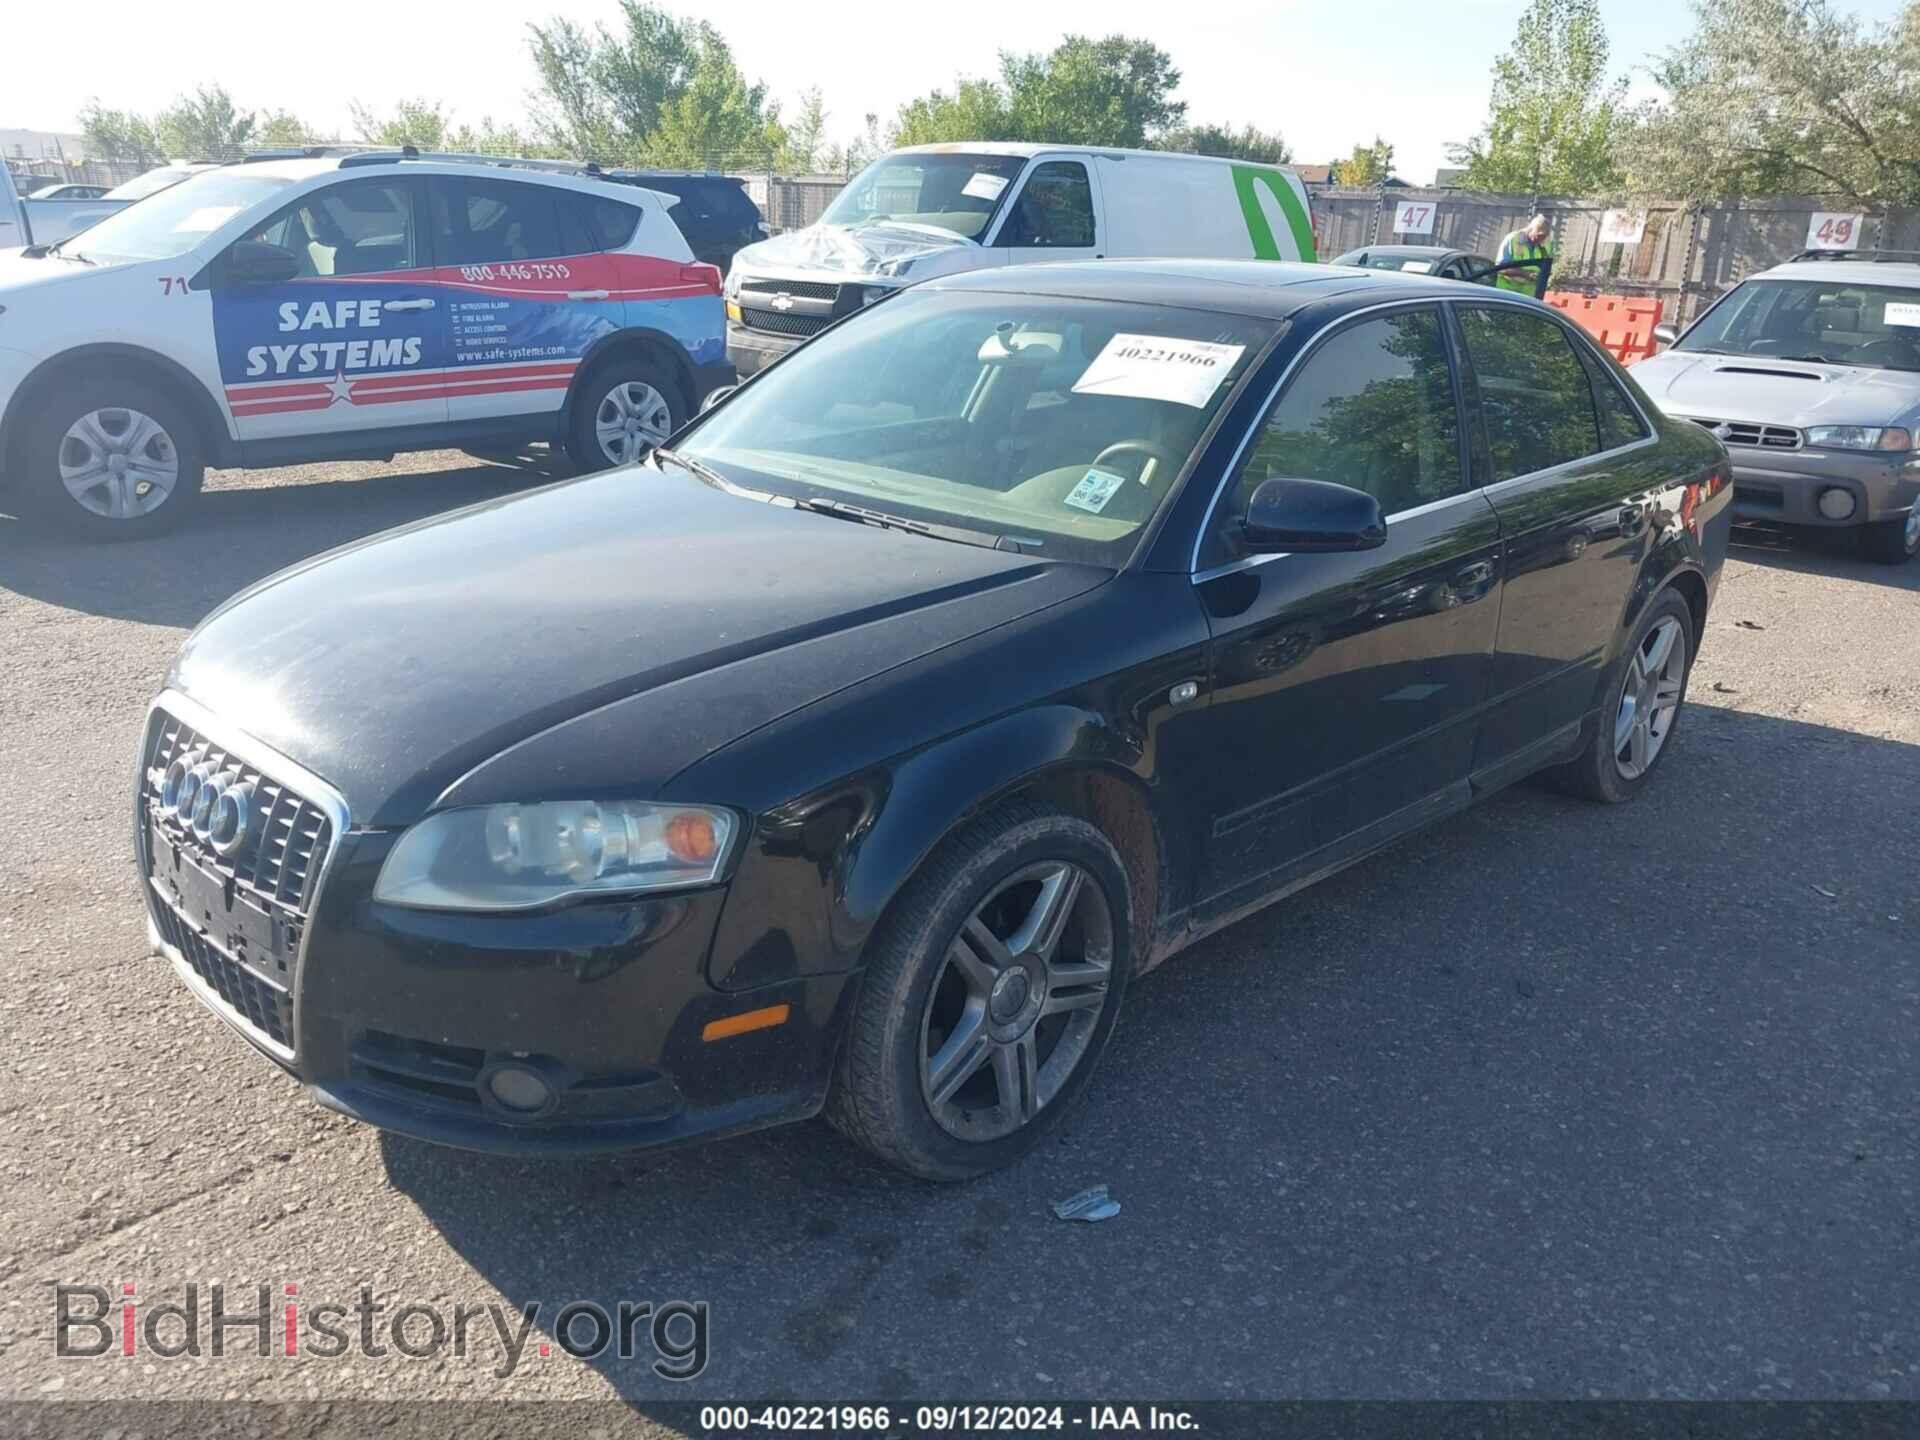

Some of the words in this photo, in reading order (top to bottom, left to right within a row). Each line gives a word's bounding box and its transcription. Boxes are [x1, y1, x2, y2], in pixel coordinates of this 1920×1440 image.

[1402, 207, 1430, 228] 47
[462, 264, 570, 282] 800-446-7519
[158, 277, 189, 296] 71
[279, 300, 382, 332] SAFE
[246, 337, 423, 376] SYSTEMS
[457, 346, 566, 361] www.safe-systems.com
[1113, 346, 1216, 367] 40221966
